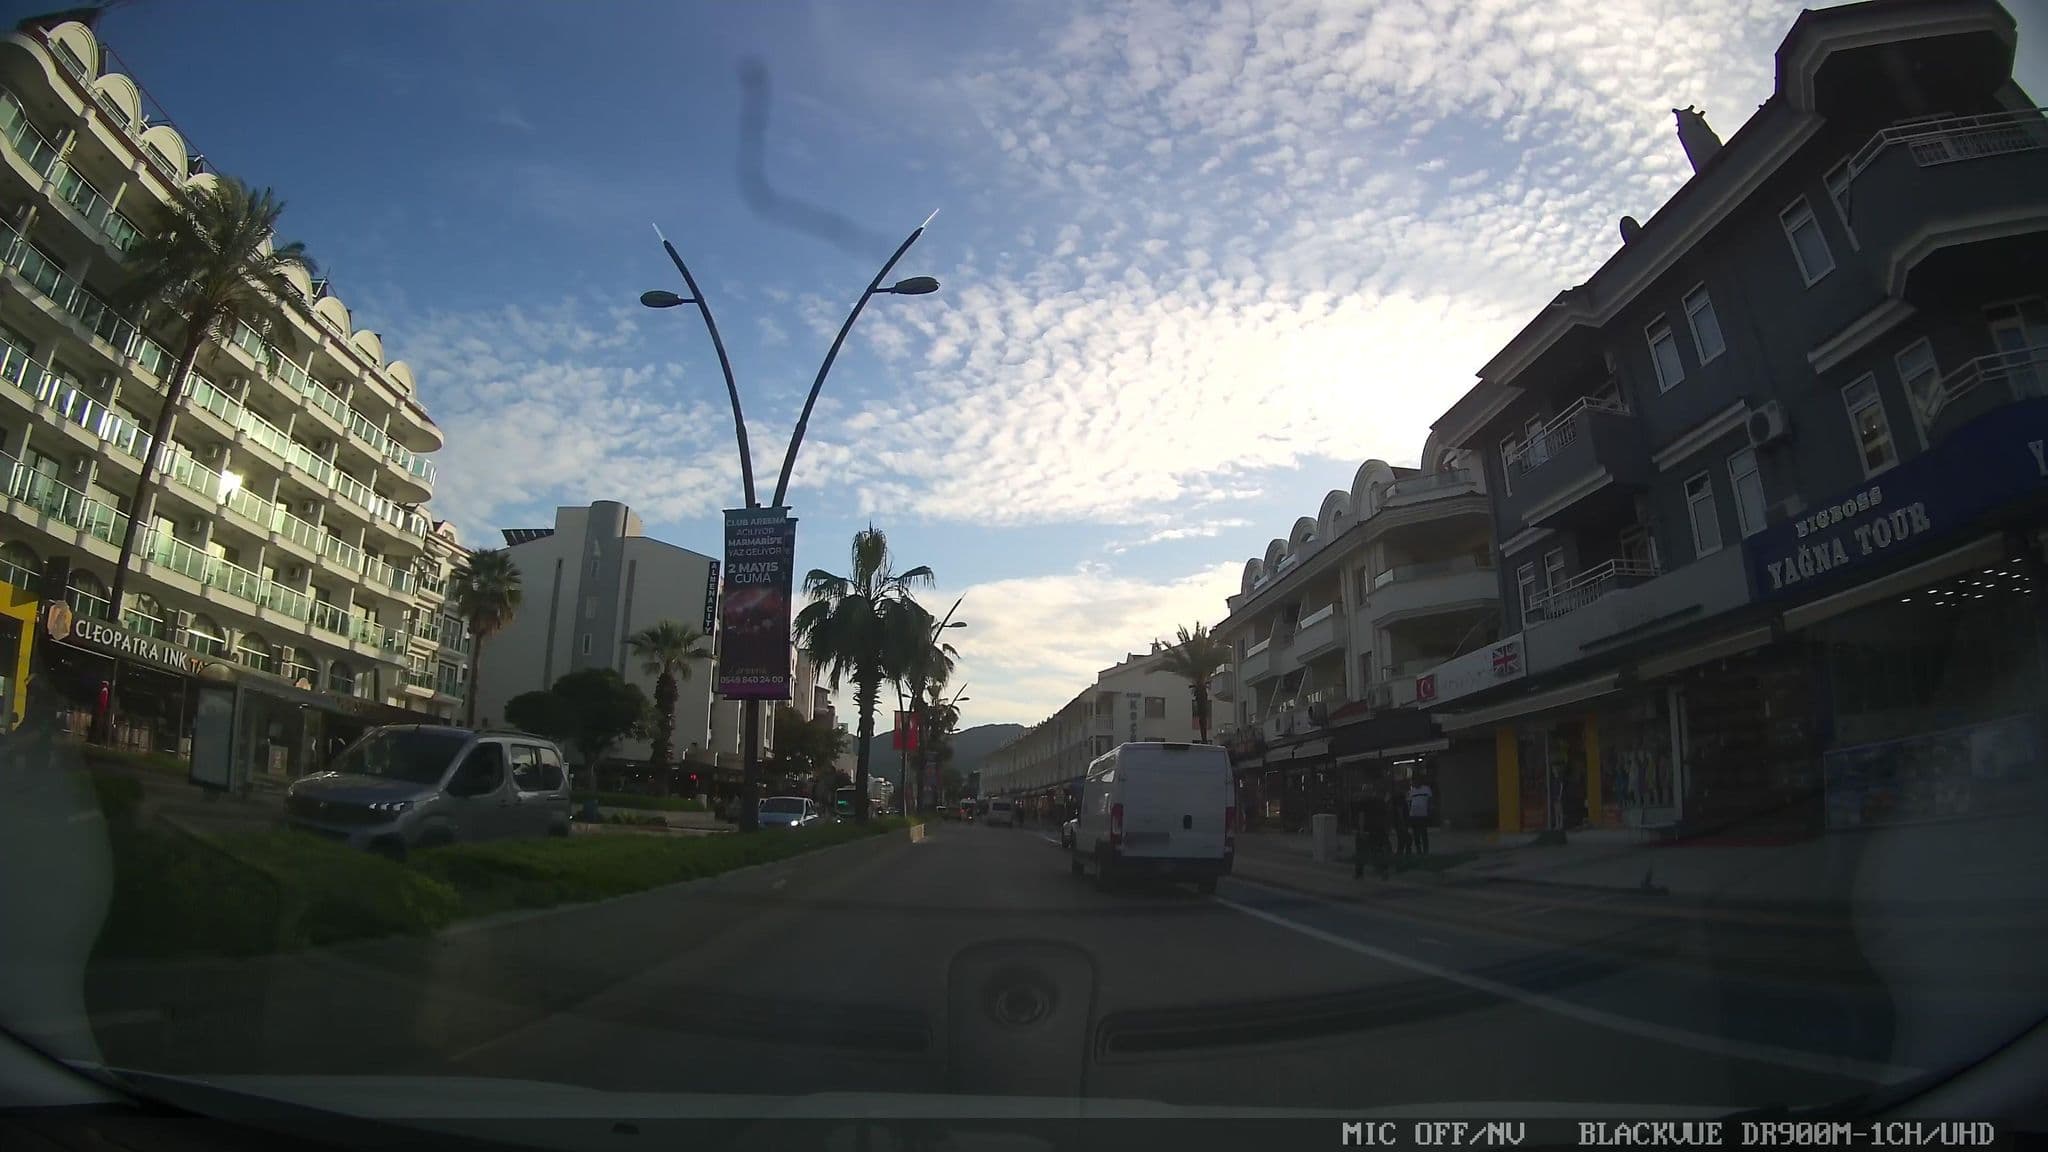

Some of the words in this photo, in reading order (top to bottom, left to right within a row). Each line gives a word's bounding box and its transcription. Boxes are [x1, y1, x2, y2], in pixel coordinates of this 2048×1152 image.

[1794, 486, 1884, 538] BIGBOSS
[727, 519, 749, 527] CLUB
[1854, 501, 1932, 556] TOUR
[728, 547, 745, 557] YAZ
[728, 563, 737, 574] 2
[739, 562, 779, 573] MAYIS
[735, 572, 772, 584] CUMA
[75, 619, 158, 662] CLEOPATRA
[164, 647, 189, 671] INK
[772, 676, 784, 684] 00
